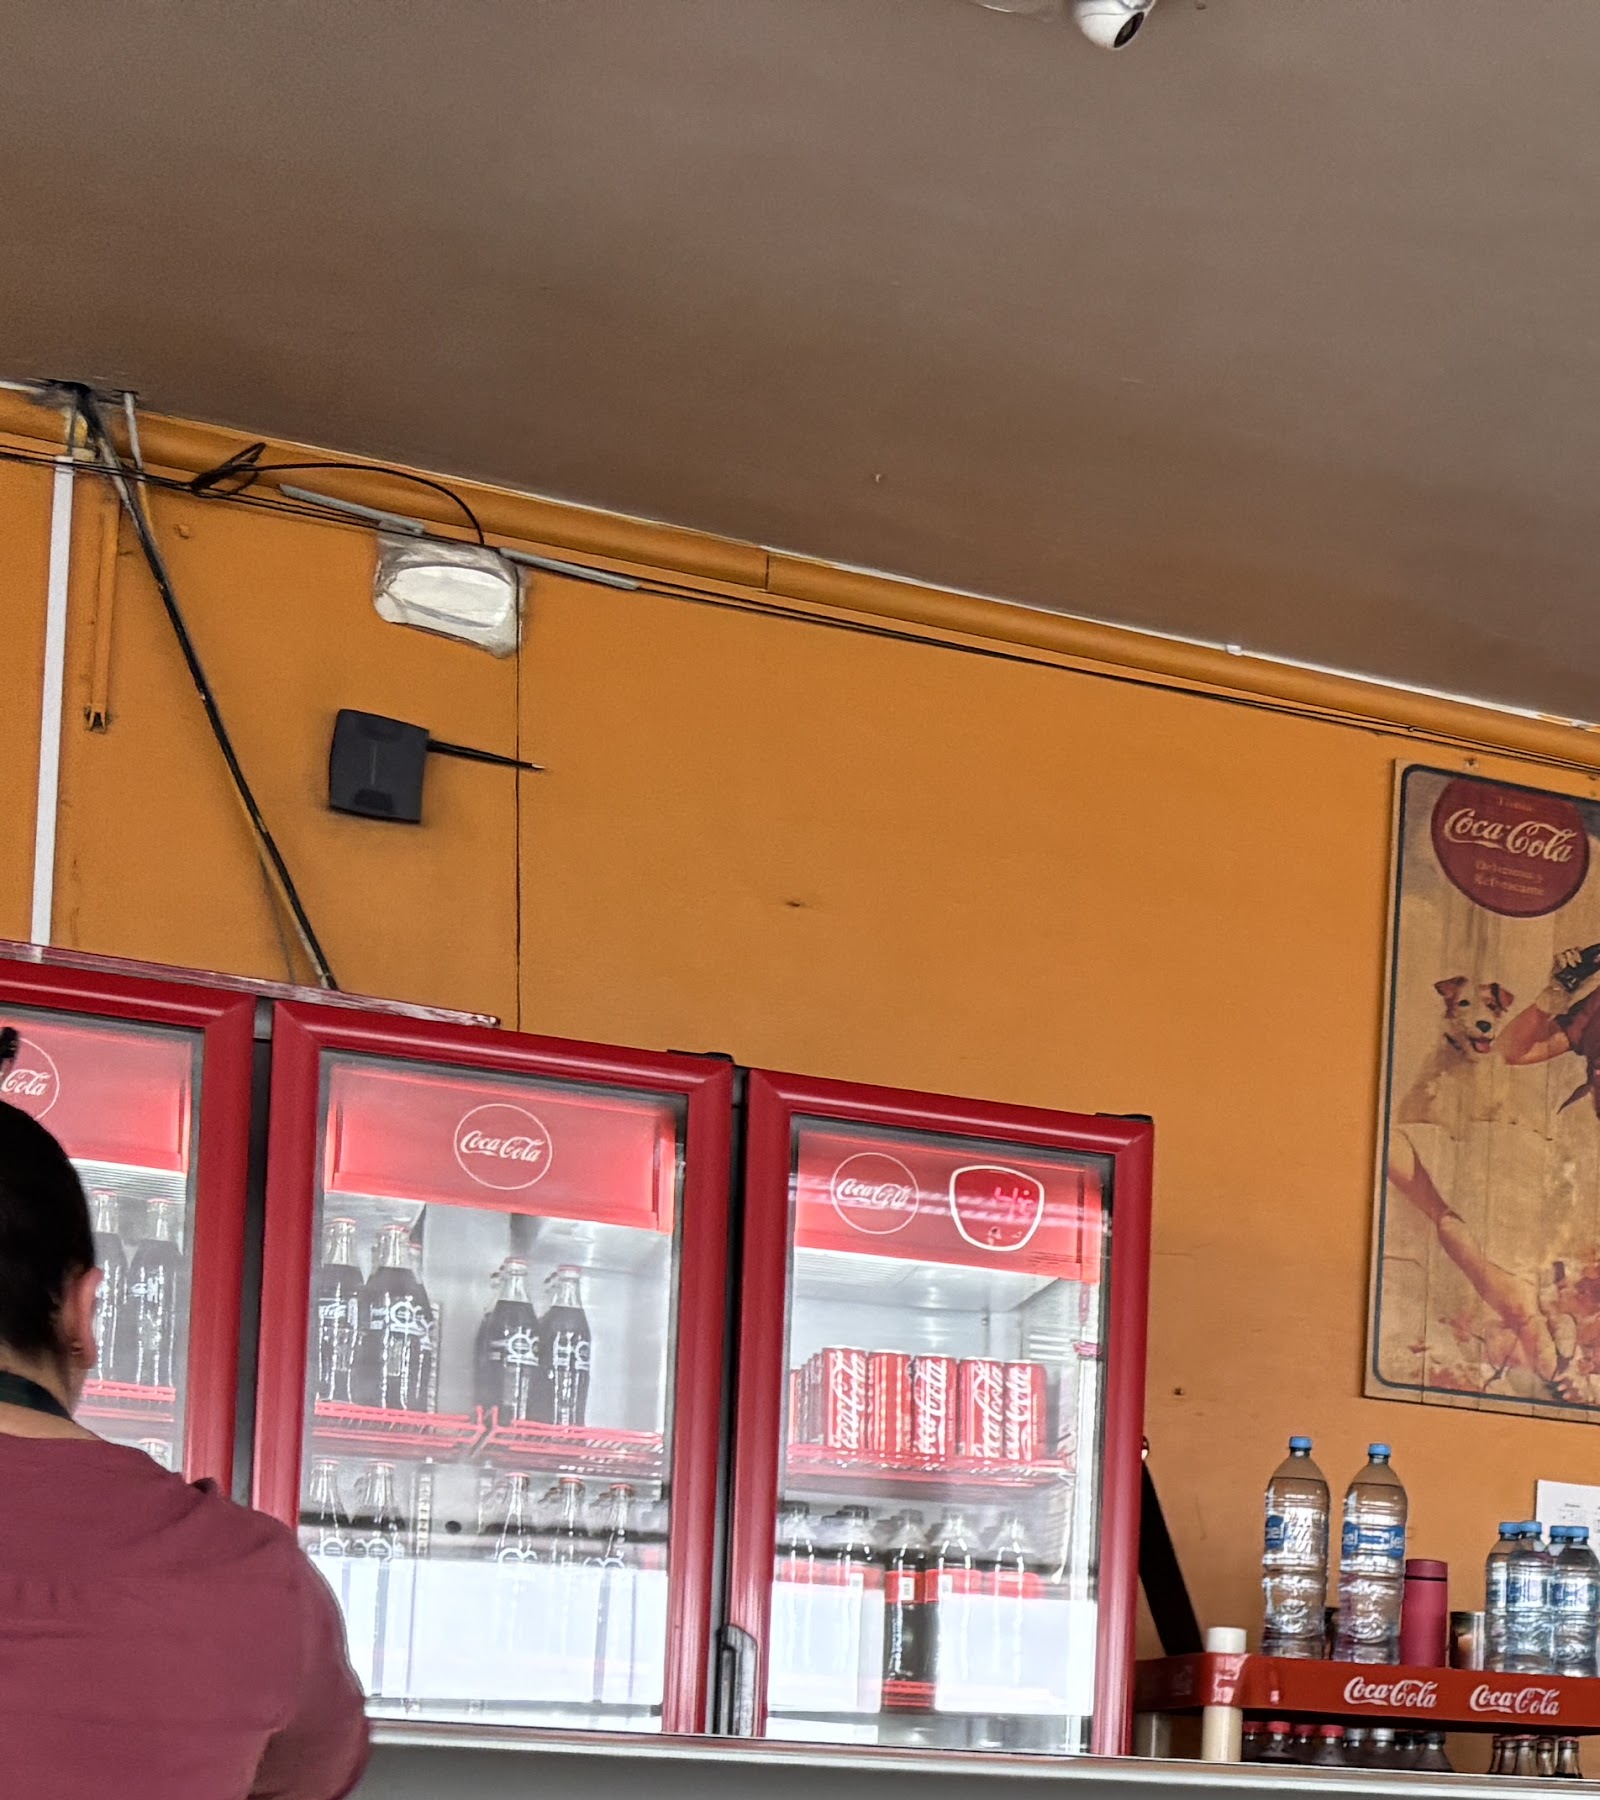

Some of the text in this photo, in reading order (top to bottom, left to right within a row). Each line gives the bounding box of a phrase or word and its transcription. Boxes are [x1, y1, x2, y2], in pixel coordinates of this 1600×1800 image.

[1444, 807, 1577, 863] Coca-Cola
[460, 1130, 545, 1162] Coca-Cola
[1343, 1676, 1438, 1708] Coca-Cola
[1470, 1684, 1560, 1716] Coca-Cola
